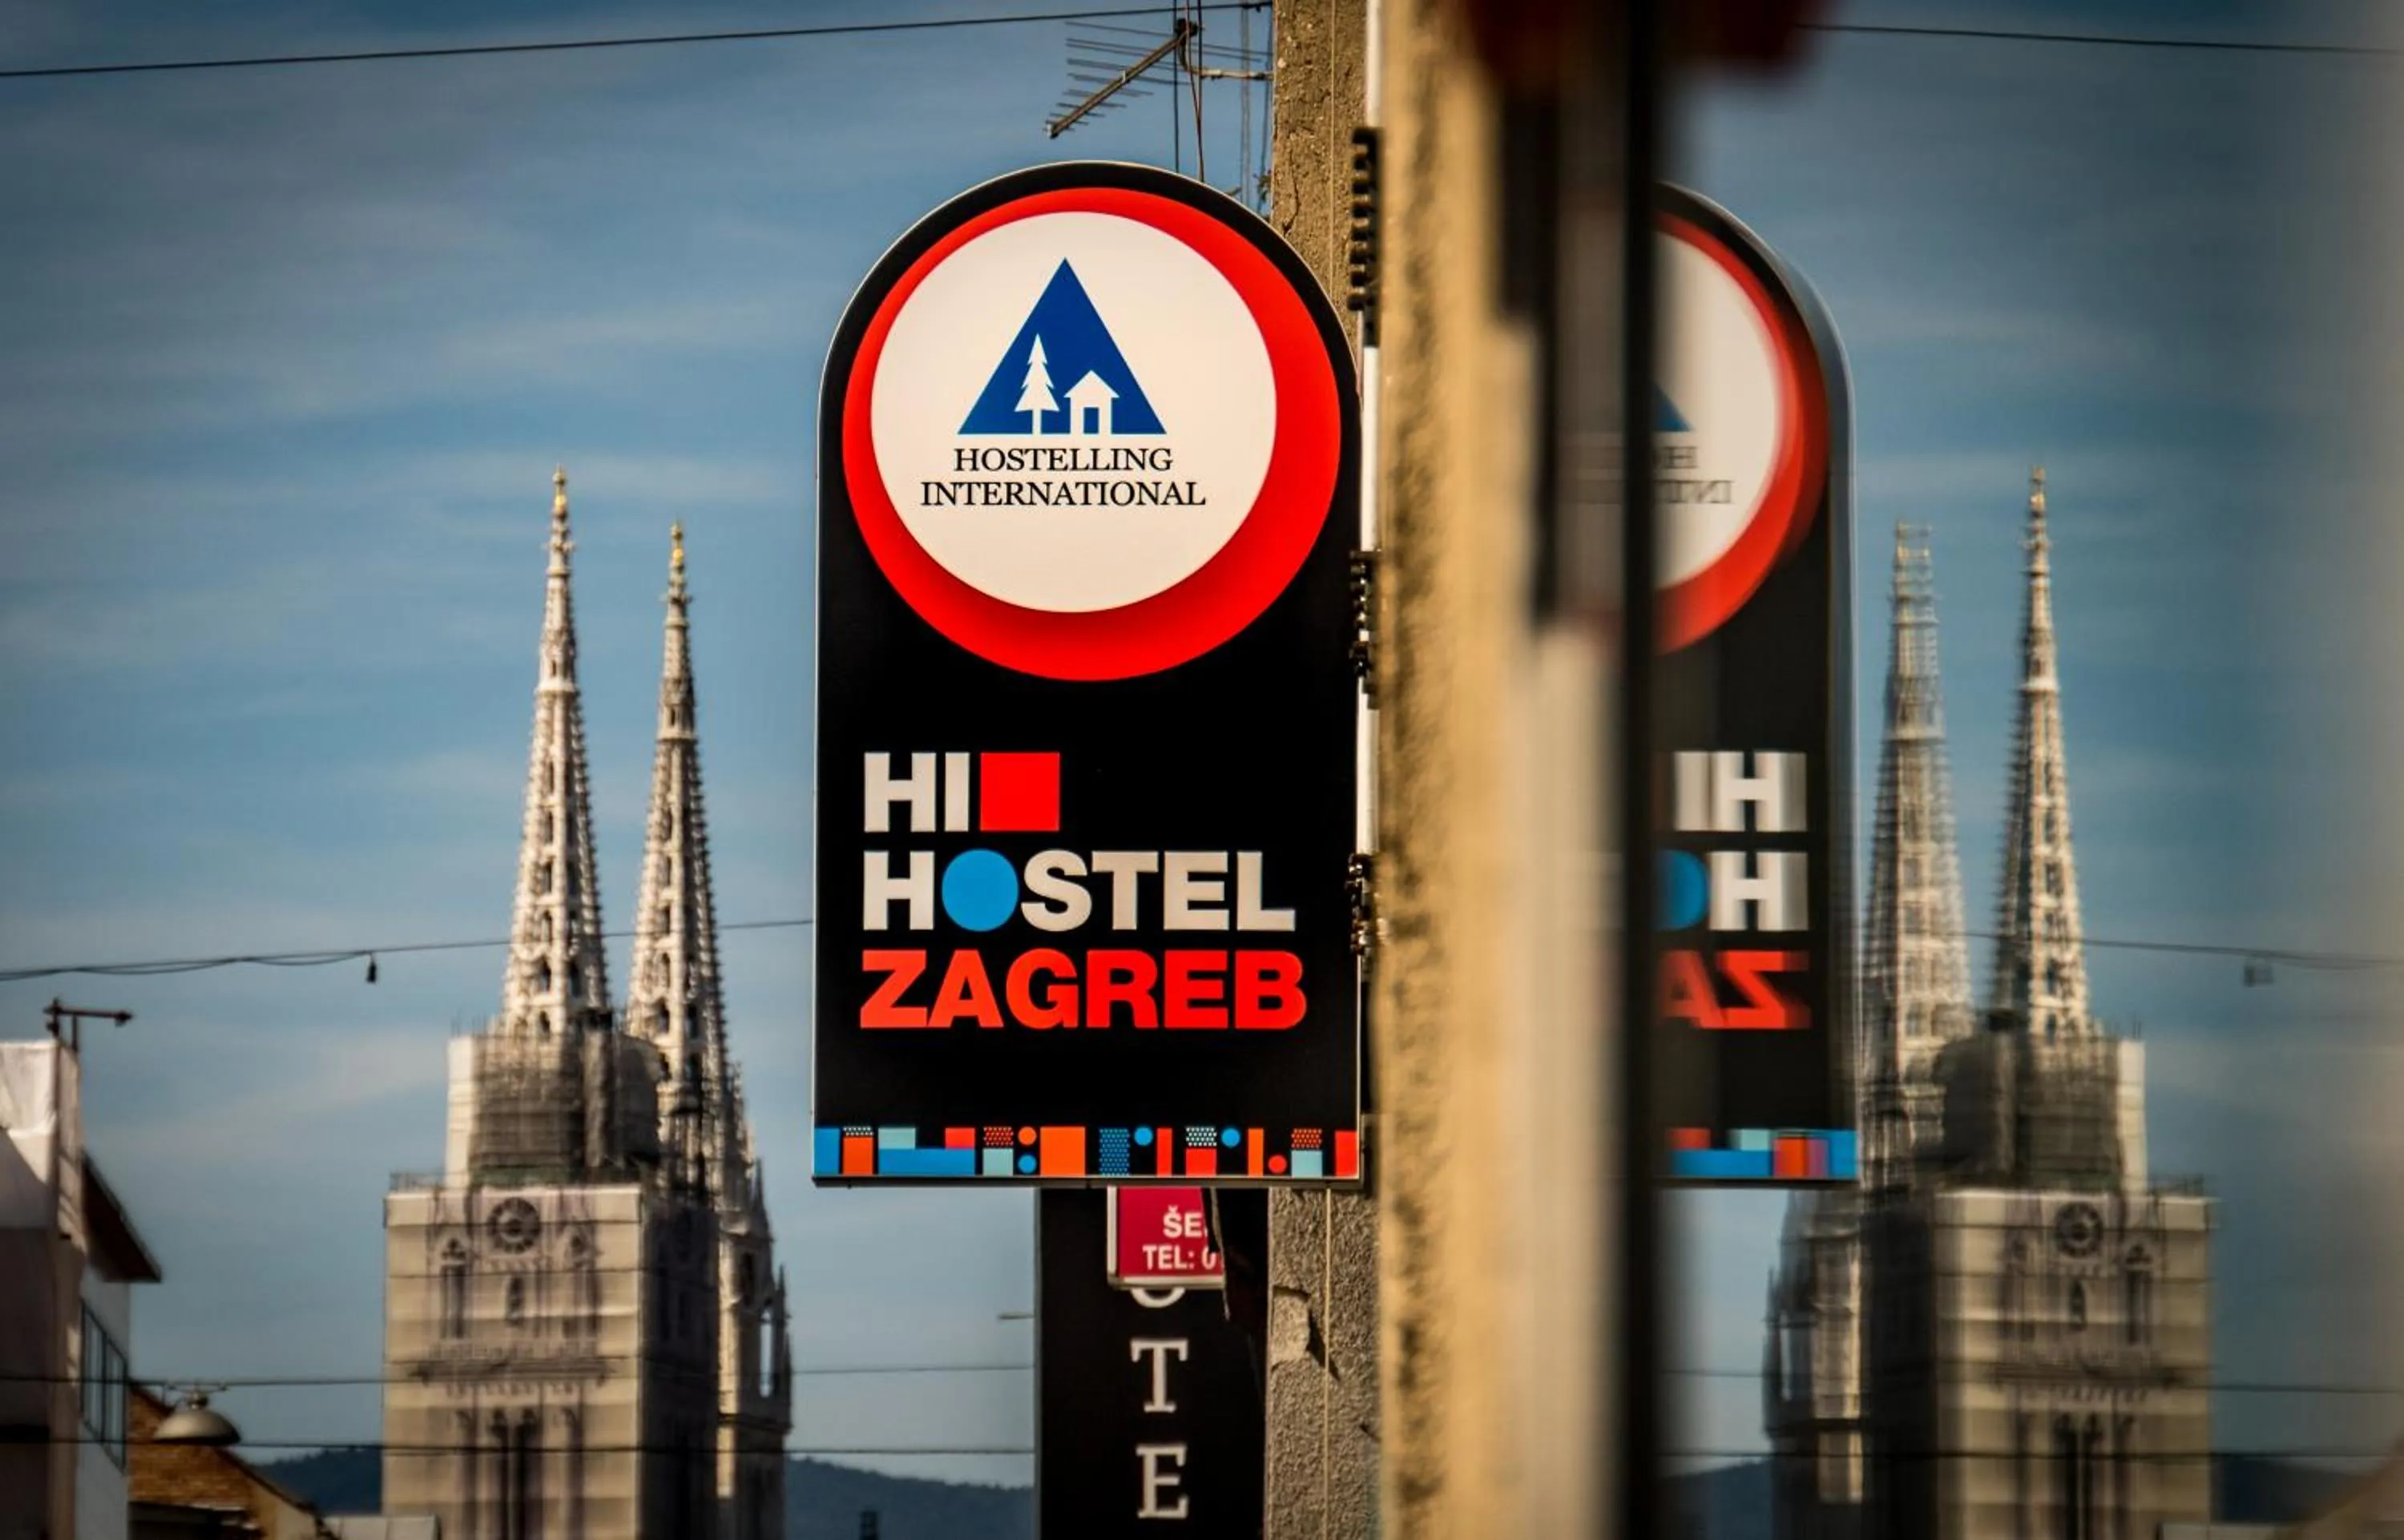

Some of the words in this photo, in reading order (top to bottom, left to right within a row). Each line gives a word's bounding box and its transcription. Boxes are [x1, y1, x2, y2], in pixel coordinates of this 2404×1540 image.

[954, 448, 1173, 471] HOSTELLING
[921, 481, 1206, 506] INTERNATIONAL
[865, 752, 970, 832] HI
[863, 849, 1296, 932] HOSTEL
[860, 948, 1308, 1030] ZAGREB
[1163, 1204, 1208, 1238] ŠE
[1142, 1244, 1195, 1270] TEL:
